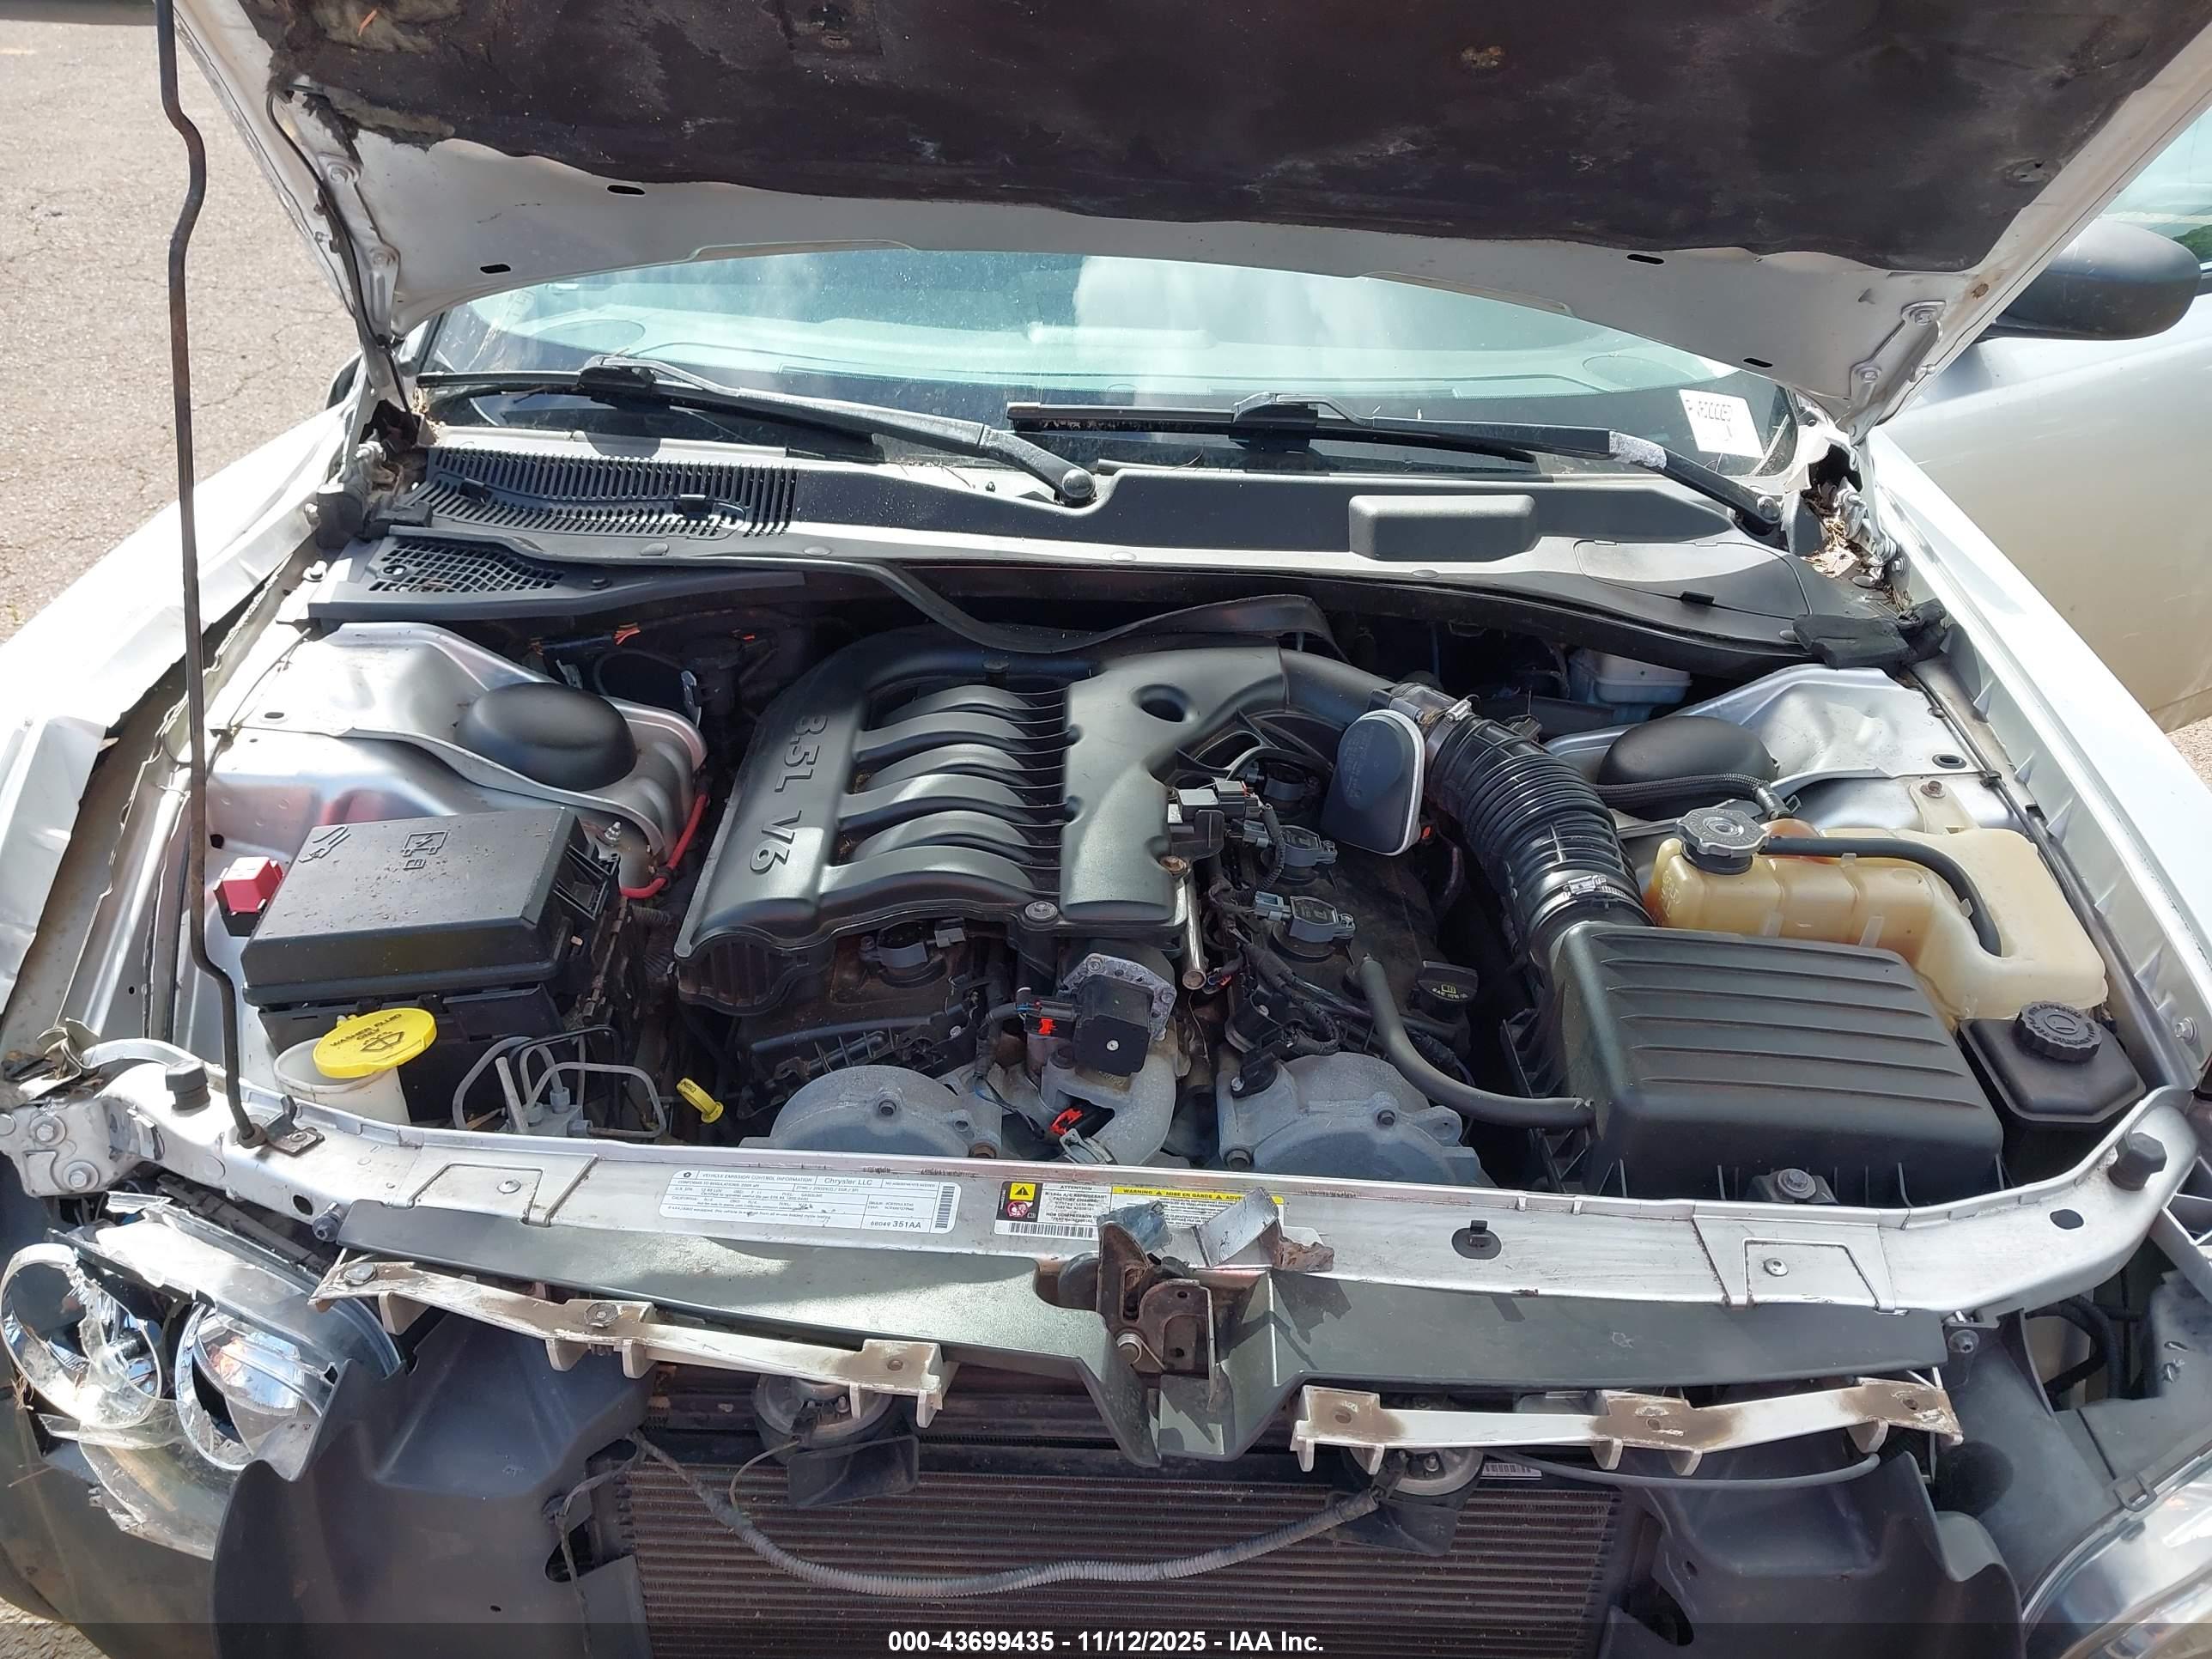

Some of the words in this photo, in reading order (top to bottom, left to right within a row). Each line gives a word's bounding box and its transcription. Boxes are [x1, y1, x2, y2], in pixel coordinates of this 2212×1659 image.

[775, 714, 828, 793] 3.5L
[750, 810, 802, 874] V6
[330, 1027, 372, 1046] WASHER
[374, 1013, 402, 1027] FLUID
[356, 1028, 380, 1040] ONLY
[824, 1177, 856, 1186] Chrysler
[892, 1220, 922, 1229] 351AA
